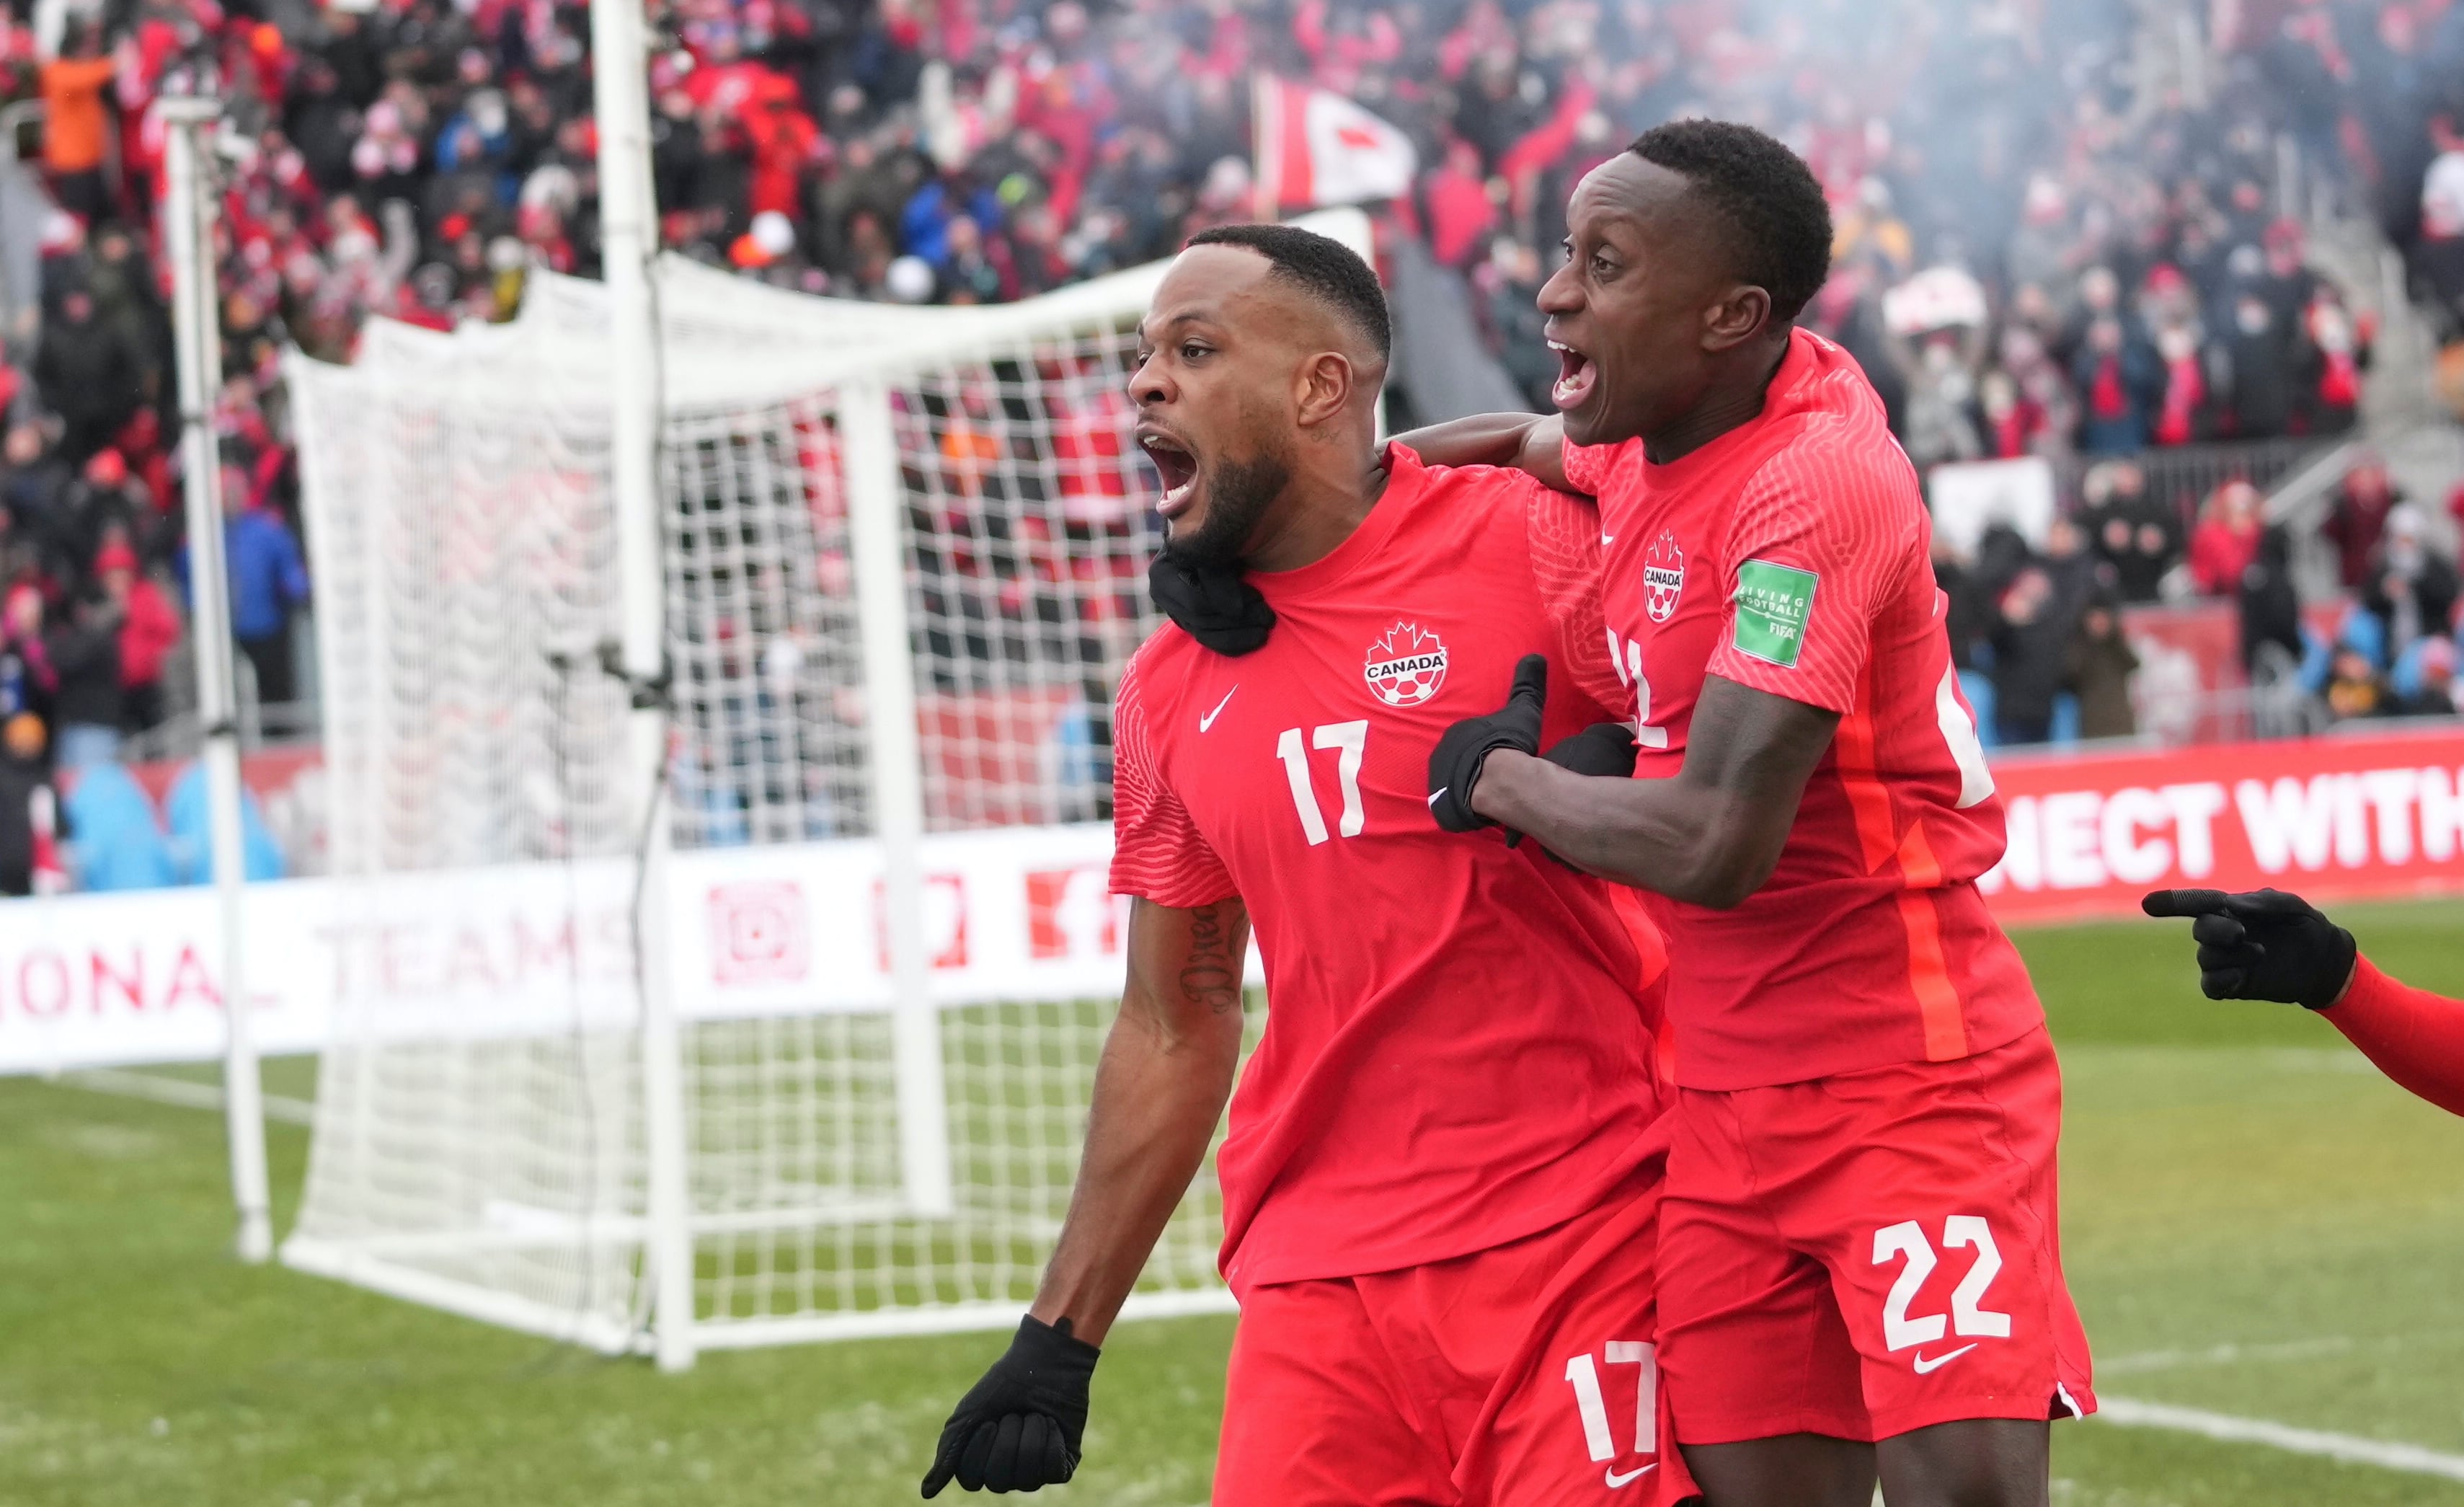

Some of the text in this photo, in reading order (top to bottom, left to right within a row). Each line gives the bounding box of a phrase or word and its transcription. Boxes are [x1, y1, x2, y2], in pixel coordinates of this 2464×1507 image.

[1645, 570, 1680, 587] CANADA
[1740, 585, 1804, 607] LIVING
[1769, 622, 1795, 640] FIFA
[1367, 655, 1444, 679] CANADA
[1276, 719, 1368, 847] 17
[1872, 1214, 2011, 1351] 22
[1564, 1340, 1656, 1462] 17
